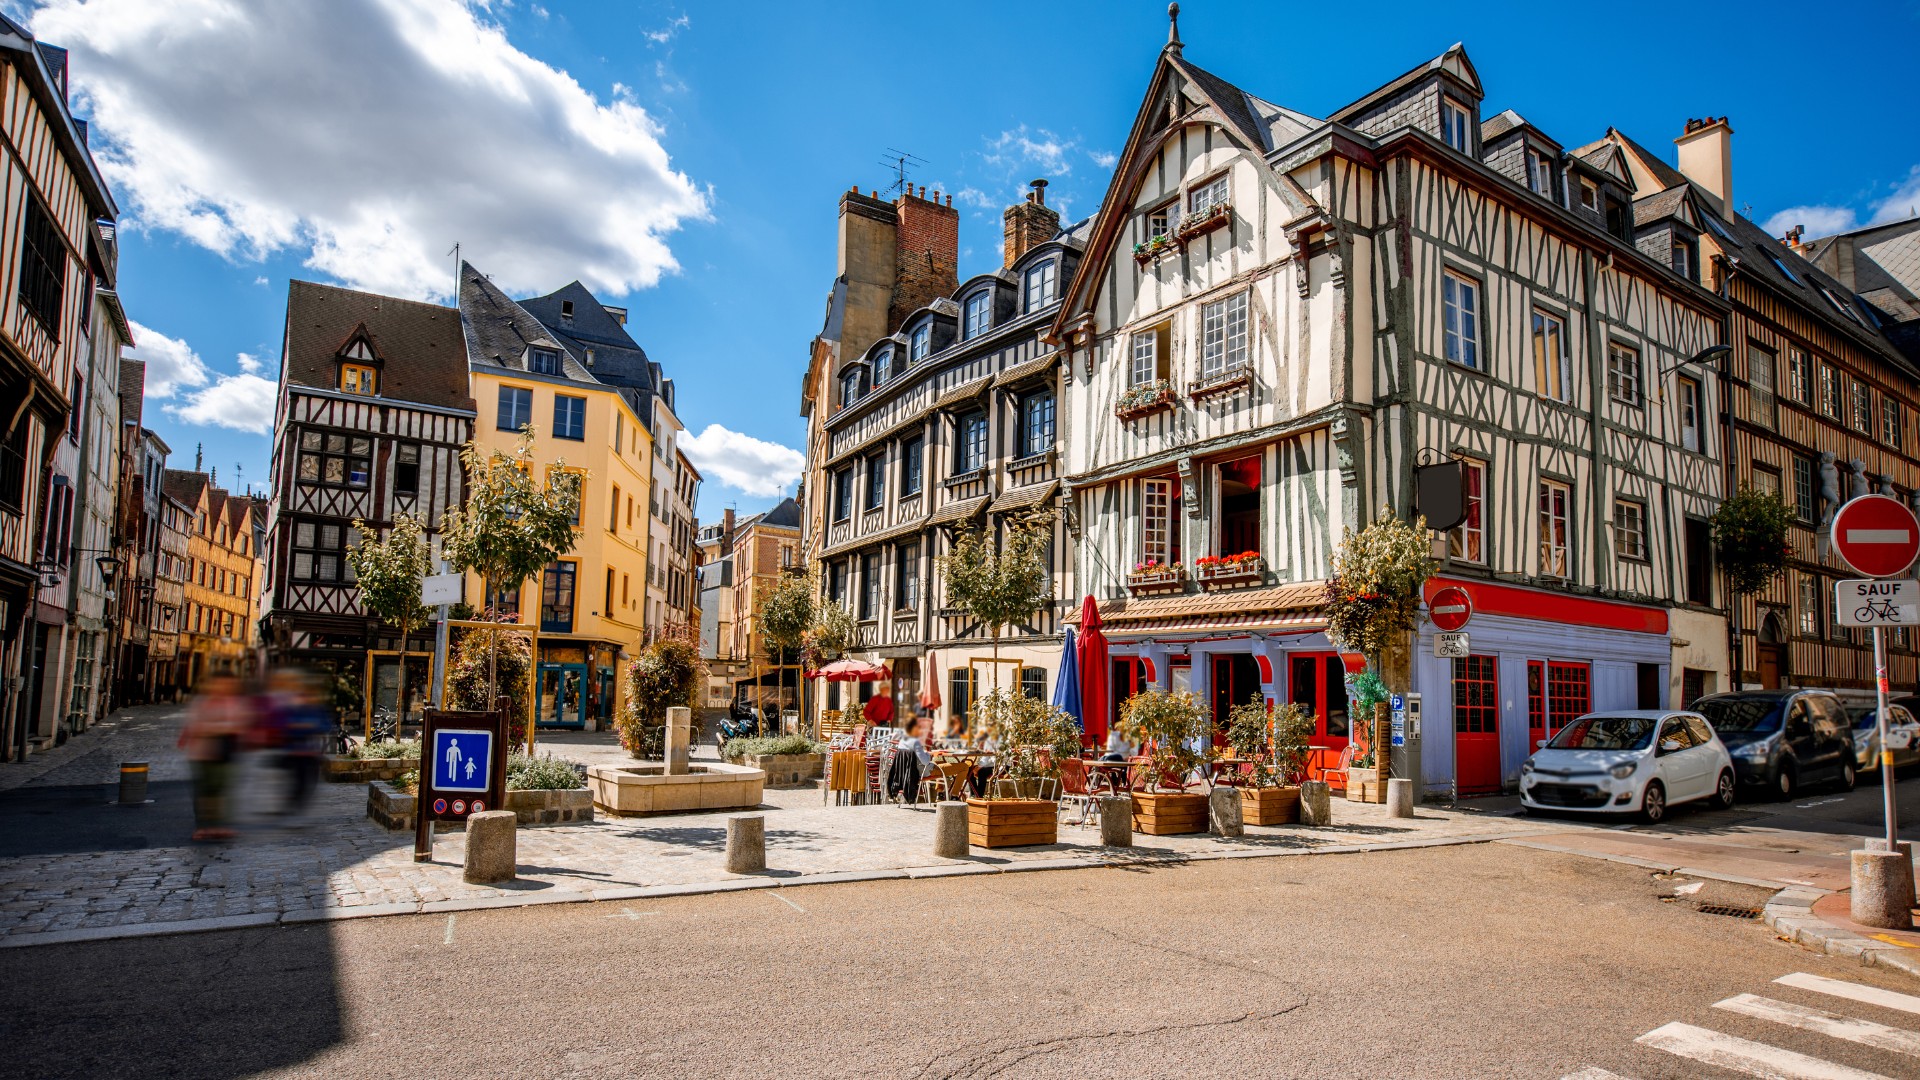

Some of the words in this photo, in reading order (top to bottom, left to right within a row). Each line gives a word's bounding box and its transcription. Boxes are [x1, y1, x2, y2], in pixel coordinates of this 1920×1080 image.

[1857, 583, 1902, 596] SAUF
[1441, 634, 1461, 642] SAUF
[1393, 698, 1400, 708] P
